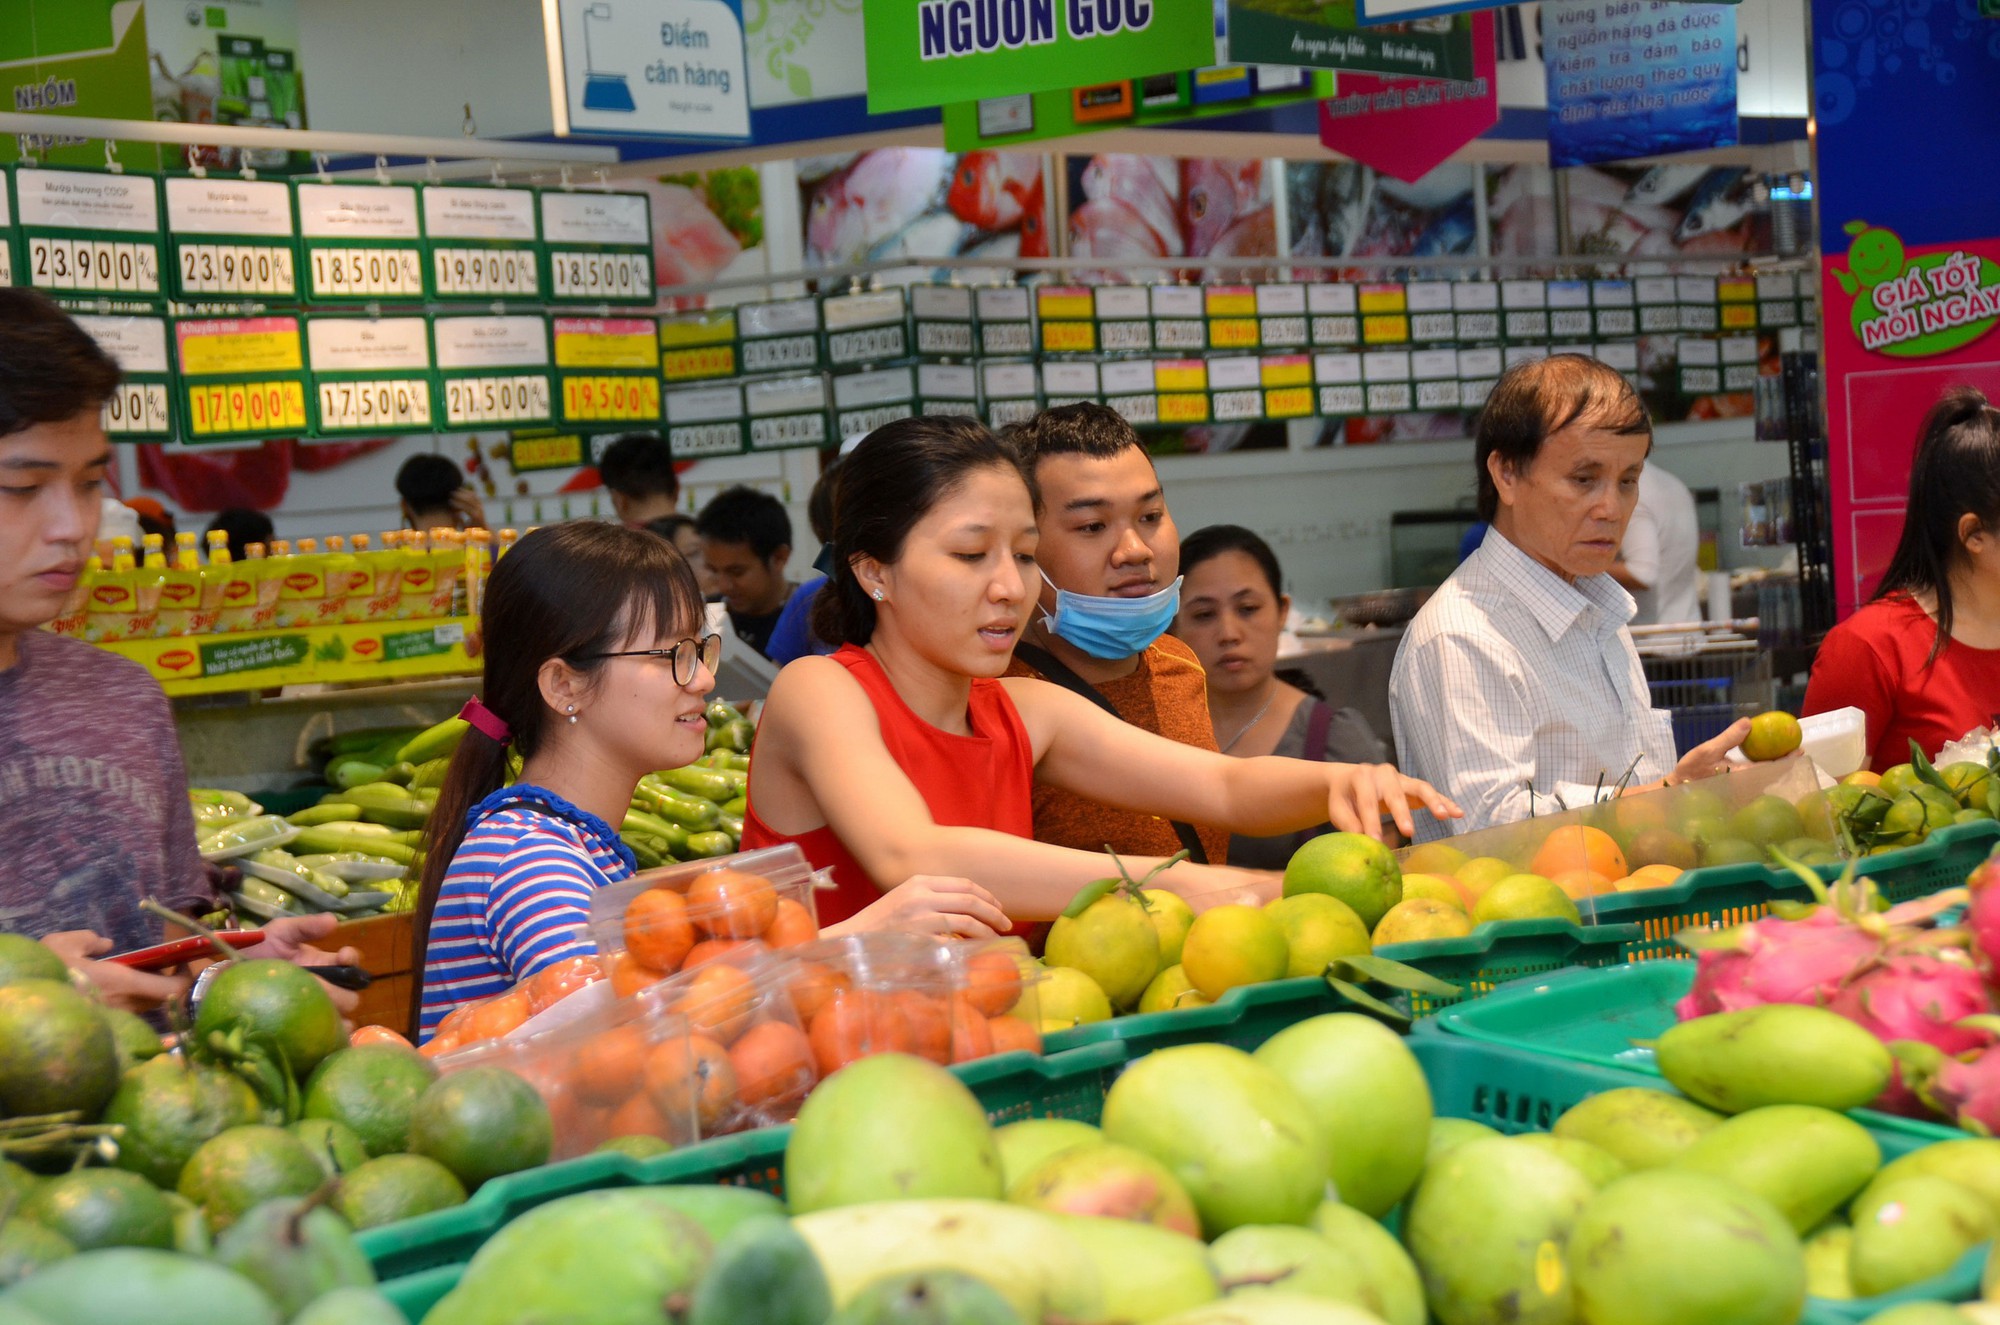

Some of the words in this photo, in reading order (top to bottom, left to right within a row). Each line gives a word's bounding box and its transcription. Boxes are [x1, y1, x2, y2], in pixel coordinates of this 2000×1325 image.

[660, 19, 710, 48] Điểm
[644, 59, 680, 85] cân
[684, 61, 732, 95] hàng
[35, 246, 132, 281] 23.900
[185, 253, 270, 282] 23.900
[316, 255, 399, 285] 18.500
[440, 256, 516, 286] 19.900
[557, 260, 630, 288] 18.500
[1872, 266, 1930, 312] GIÁ
[1926, 251, 1981, 297] TỐT
[1860, 306, 1920, 351] MỖI
[1920, 283, 2000, 334] NGÀY
[195, 388, 282, 424] 17.900
[324, 388, 409, 418] 17.500
[449, 384, 528, 415] 21.500
[568, 382, 640, 413] 19.500
